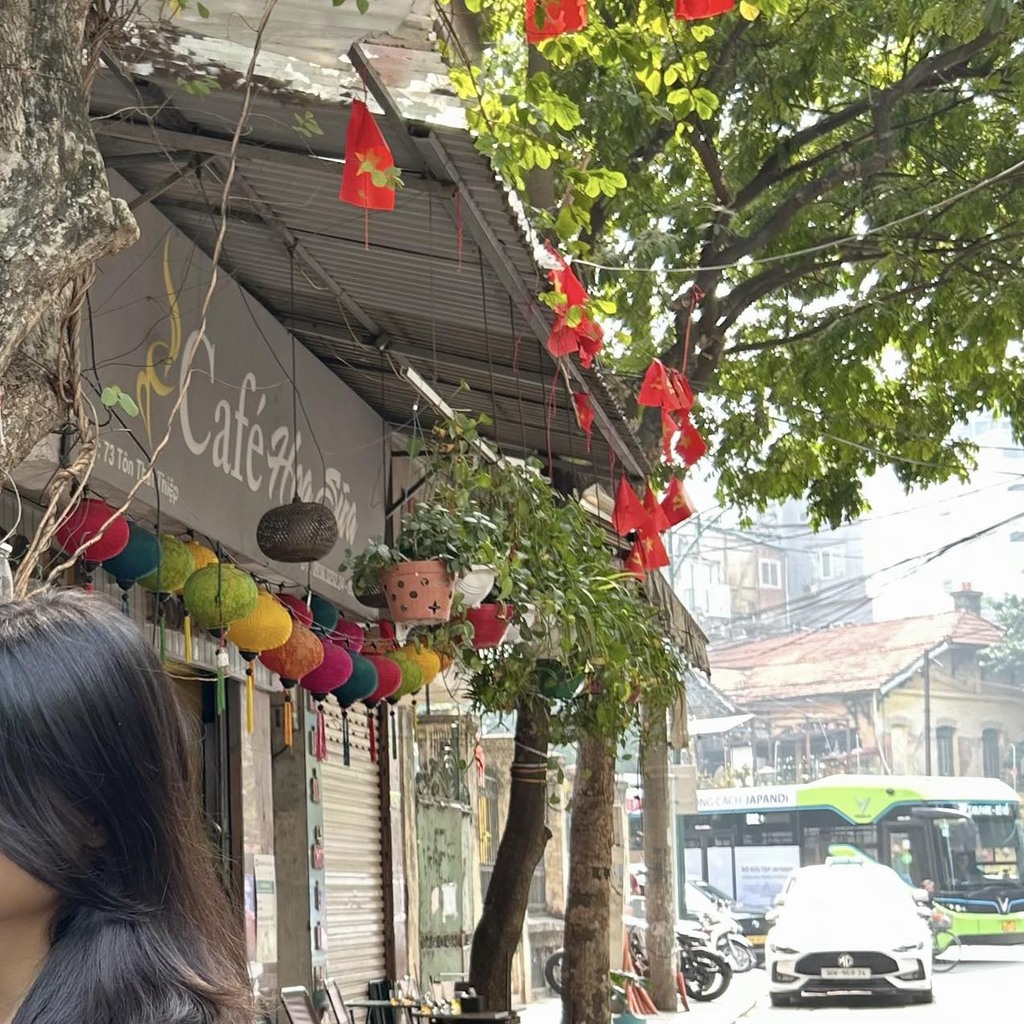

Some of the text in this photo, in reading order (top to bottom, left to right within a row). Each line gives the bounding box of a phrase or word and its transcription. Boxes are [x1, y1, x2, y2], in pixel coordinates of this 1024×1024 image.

[179, 330, 266, 492] Café
[104, 440, 115, 466] 73
[746, 793, 789, 805] JAPANDI
